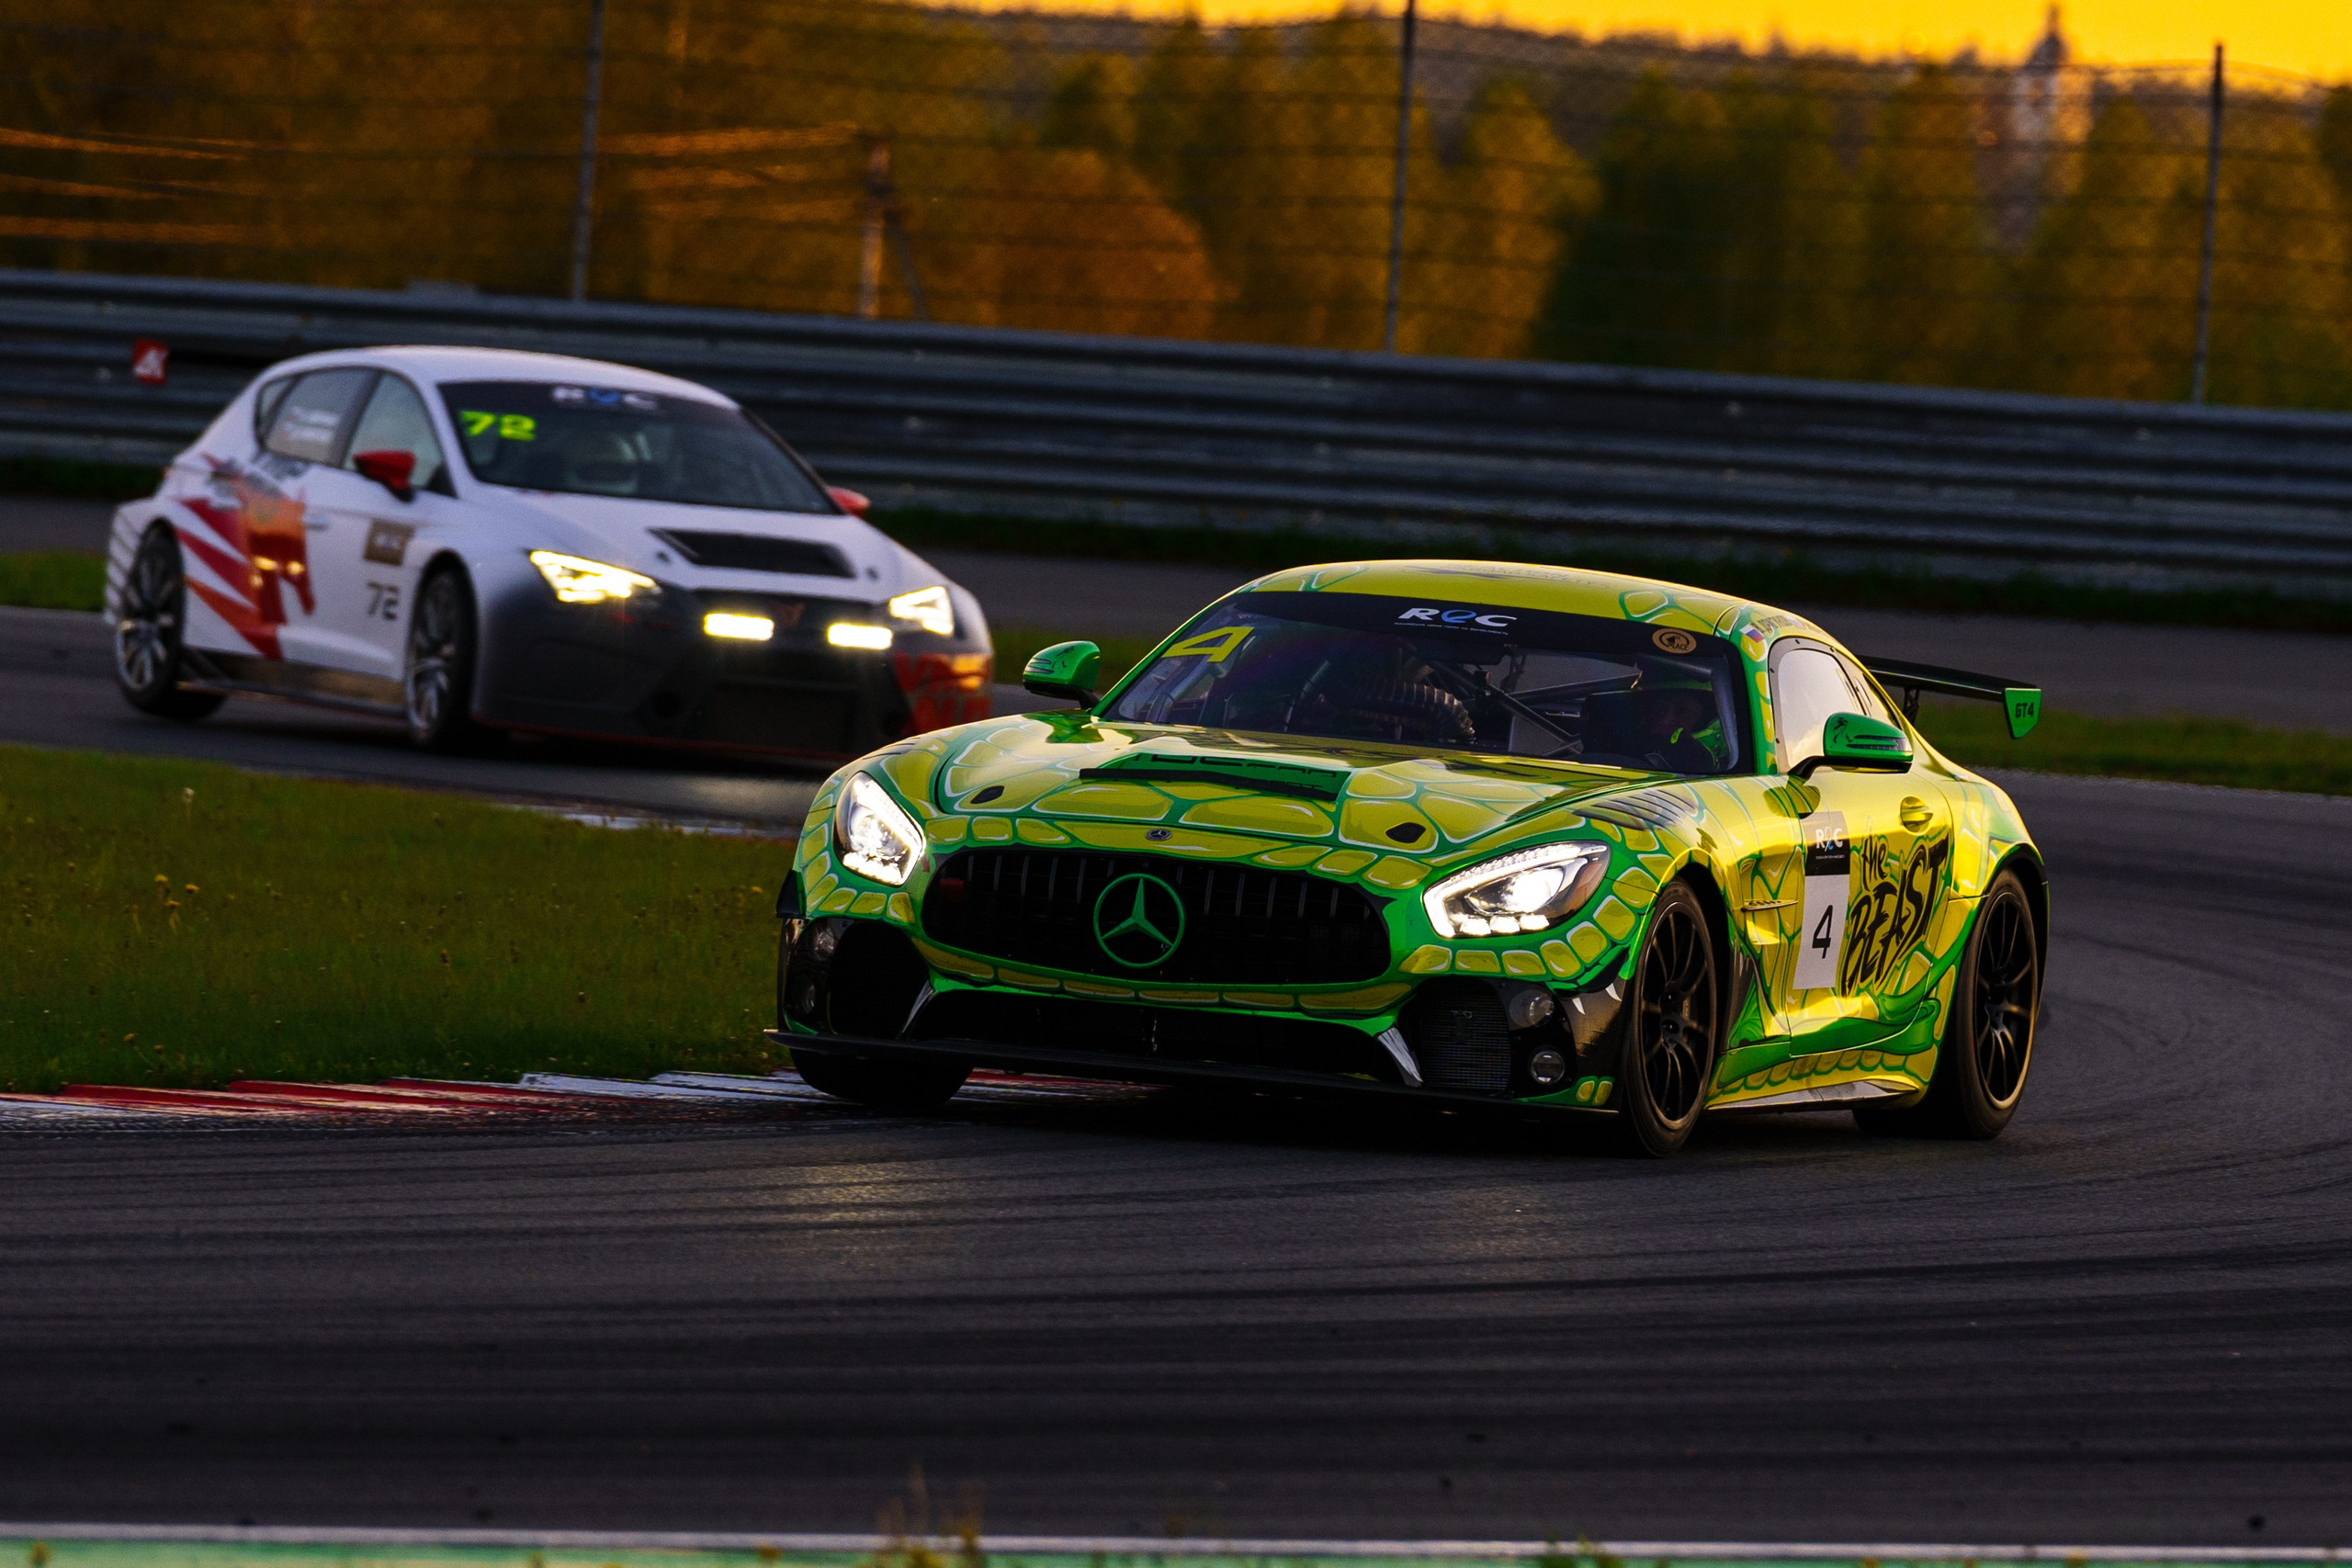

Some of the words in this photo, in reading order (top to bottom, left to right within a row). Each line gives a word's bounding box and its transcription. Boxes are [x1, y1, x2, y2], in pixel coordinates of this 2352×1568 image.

[460, 411, 537, 442] 72
[367, 581, 399, 620] 72
[1161, 626, 1255, 663] 4
[2015, 702, 2035, 718] GT4
[1812, 905, 1834, 959] 4
[1841, 831, 1950, 998] BEAST
